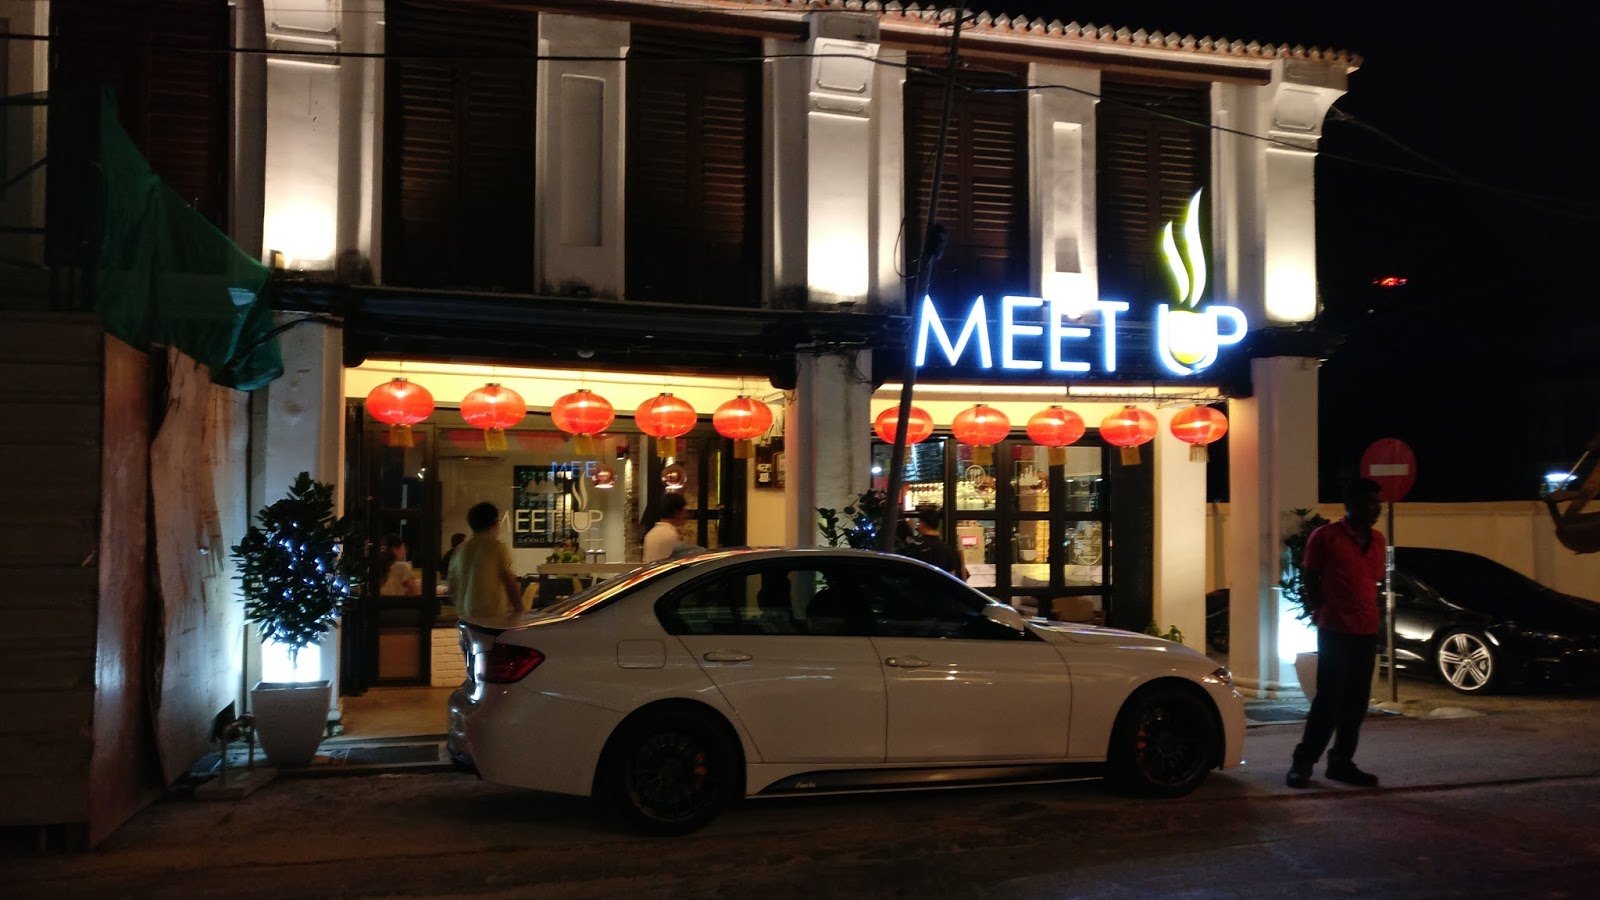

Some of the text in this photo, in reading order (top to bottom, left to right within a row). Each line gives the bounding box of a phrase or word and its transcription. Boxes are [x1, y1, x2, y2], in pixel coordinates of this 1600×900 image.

[914, 294, 1249, 376] MEET UP
[570, 509, 604, 533] UP
